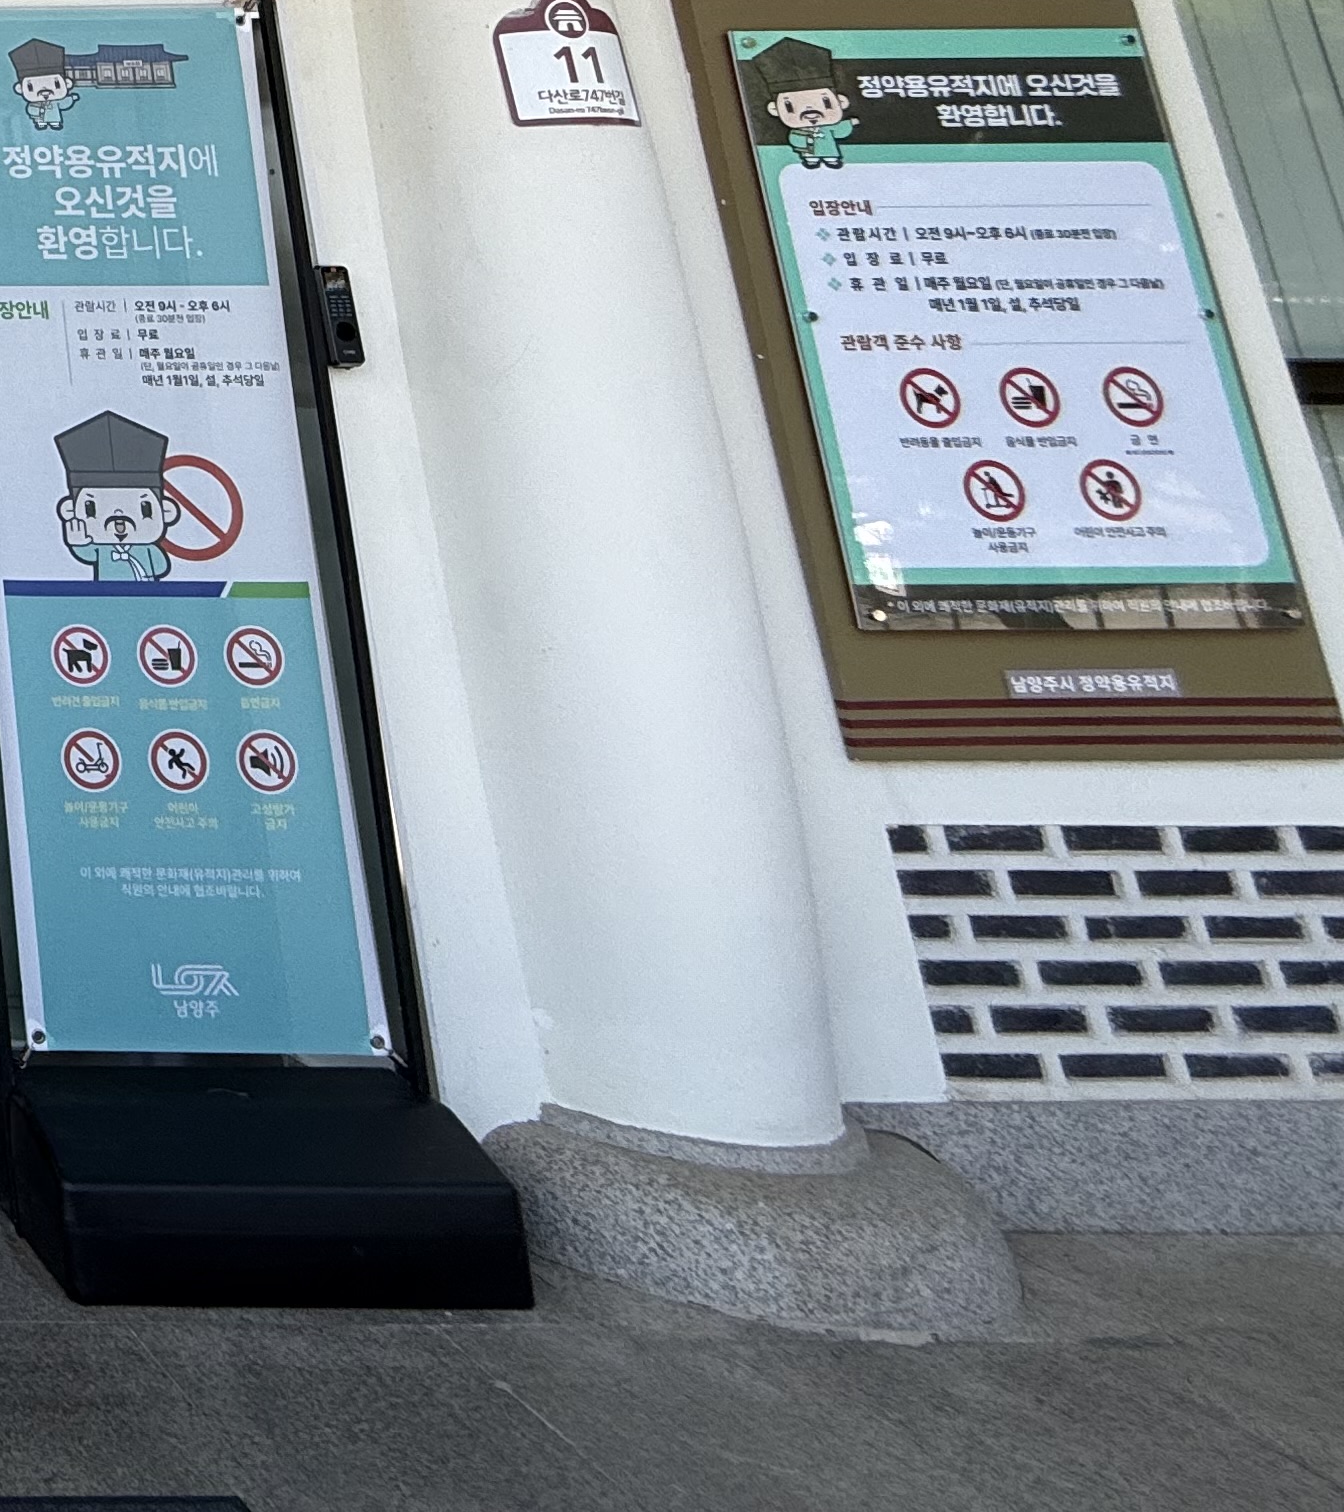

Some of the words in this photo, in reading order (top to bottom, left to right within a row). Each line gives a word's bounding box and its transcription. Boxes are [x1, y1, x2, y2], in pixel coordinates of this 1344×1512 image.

[553, 46, 604, 83] 11
[856, 74, 1023, 98] 정약용유적지에
[1025, 73, 1121, 97] 오신것을
[538, 89, 626, 106] 다산로747번길
[936, 103, 1063, 128] 환영합니다.
[2, 144, 219, 179] 정약용유적지에
[54, 184, 177, 219] 오신것을
[809, 200, 873, 217] 입장안내
[37, 225, 203, 260] 환영합니다.
[836, 227, 898, 242] 관람시간
[915, 227, 942, 240] 오전
[1005, 226, 1028, 240] 6시
[921, 251, 949, 265] 무료
[923, 276, 951, 291] 매주
[953, 276, 993, 291] 월요일
[74, 300, 116, 312] 관람시간
[135, 300, 156, 312] 오전
[158, 300, 177, 312] 9시
[187, 300, 209, 312] 오후
[211, 300, 230, 312] 6시
[1028, 297, 1081, 312] 추석당일
[137, 329, 159, 340] 무료
[840, 334, 890, 351] 관람객
[893, 334, 926, 350] 준수
[930, 334, 962, 351] 사항
[139, 348, 161, 359] 매주
[164, 348, 195, 360] 월요일
[142, 375, 163, 387] 매년
[222, 375, 264, 387] 추석당일
[988, 542, 1029, 553] 사용금지
[1011, 675, 1076, 694] 남양주시
[1078, 674, 1177, 693] 정약용유적지
[80, 867, 92, 880] 이
[174, 1000, 220, 1019] 남양주
